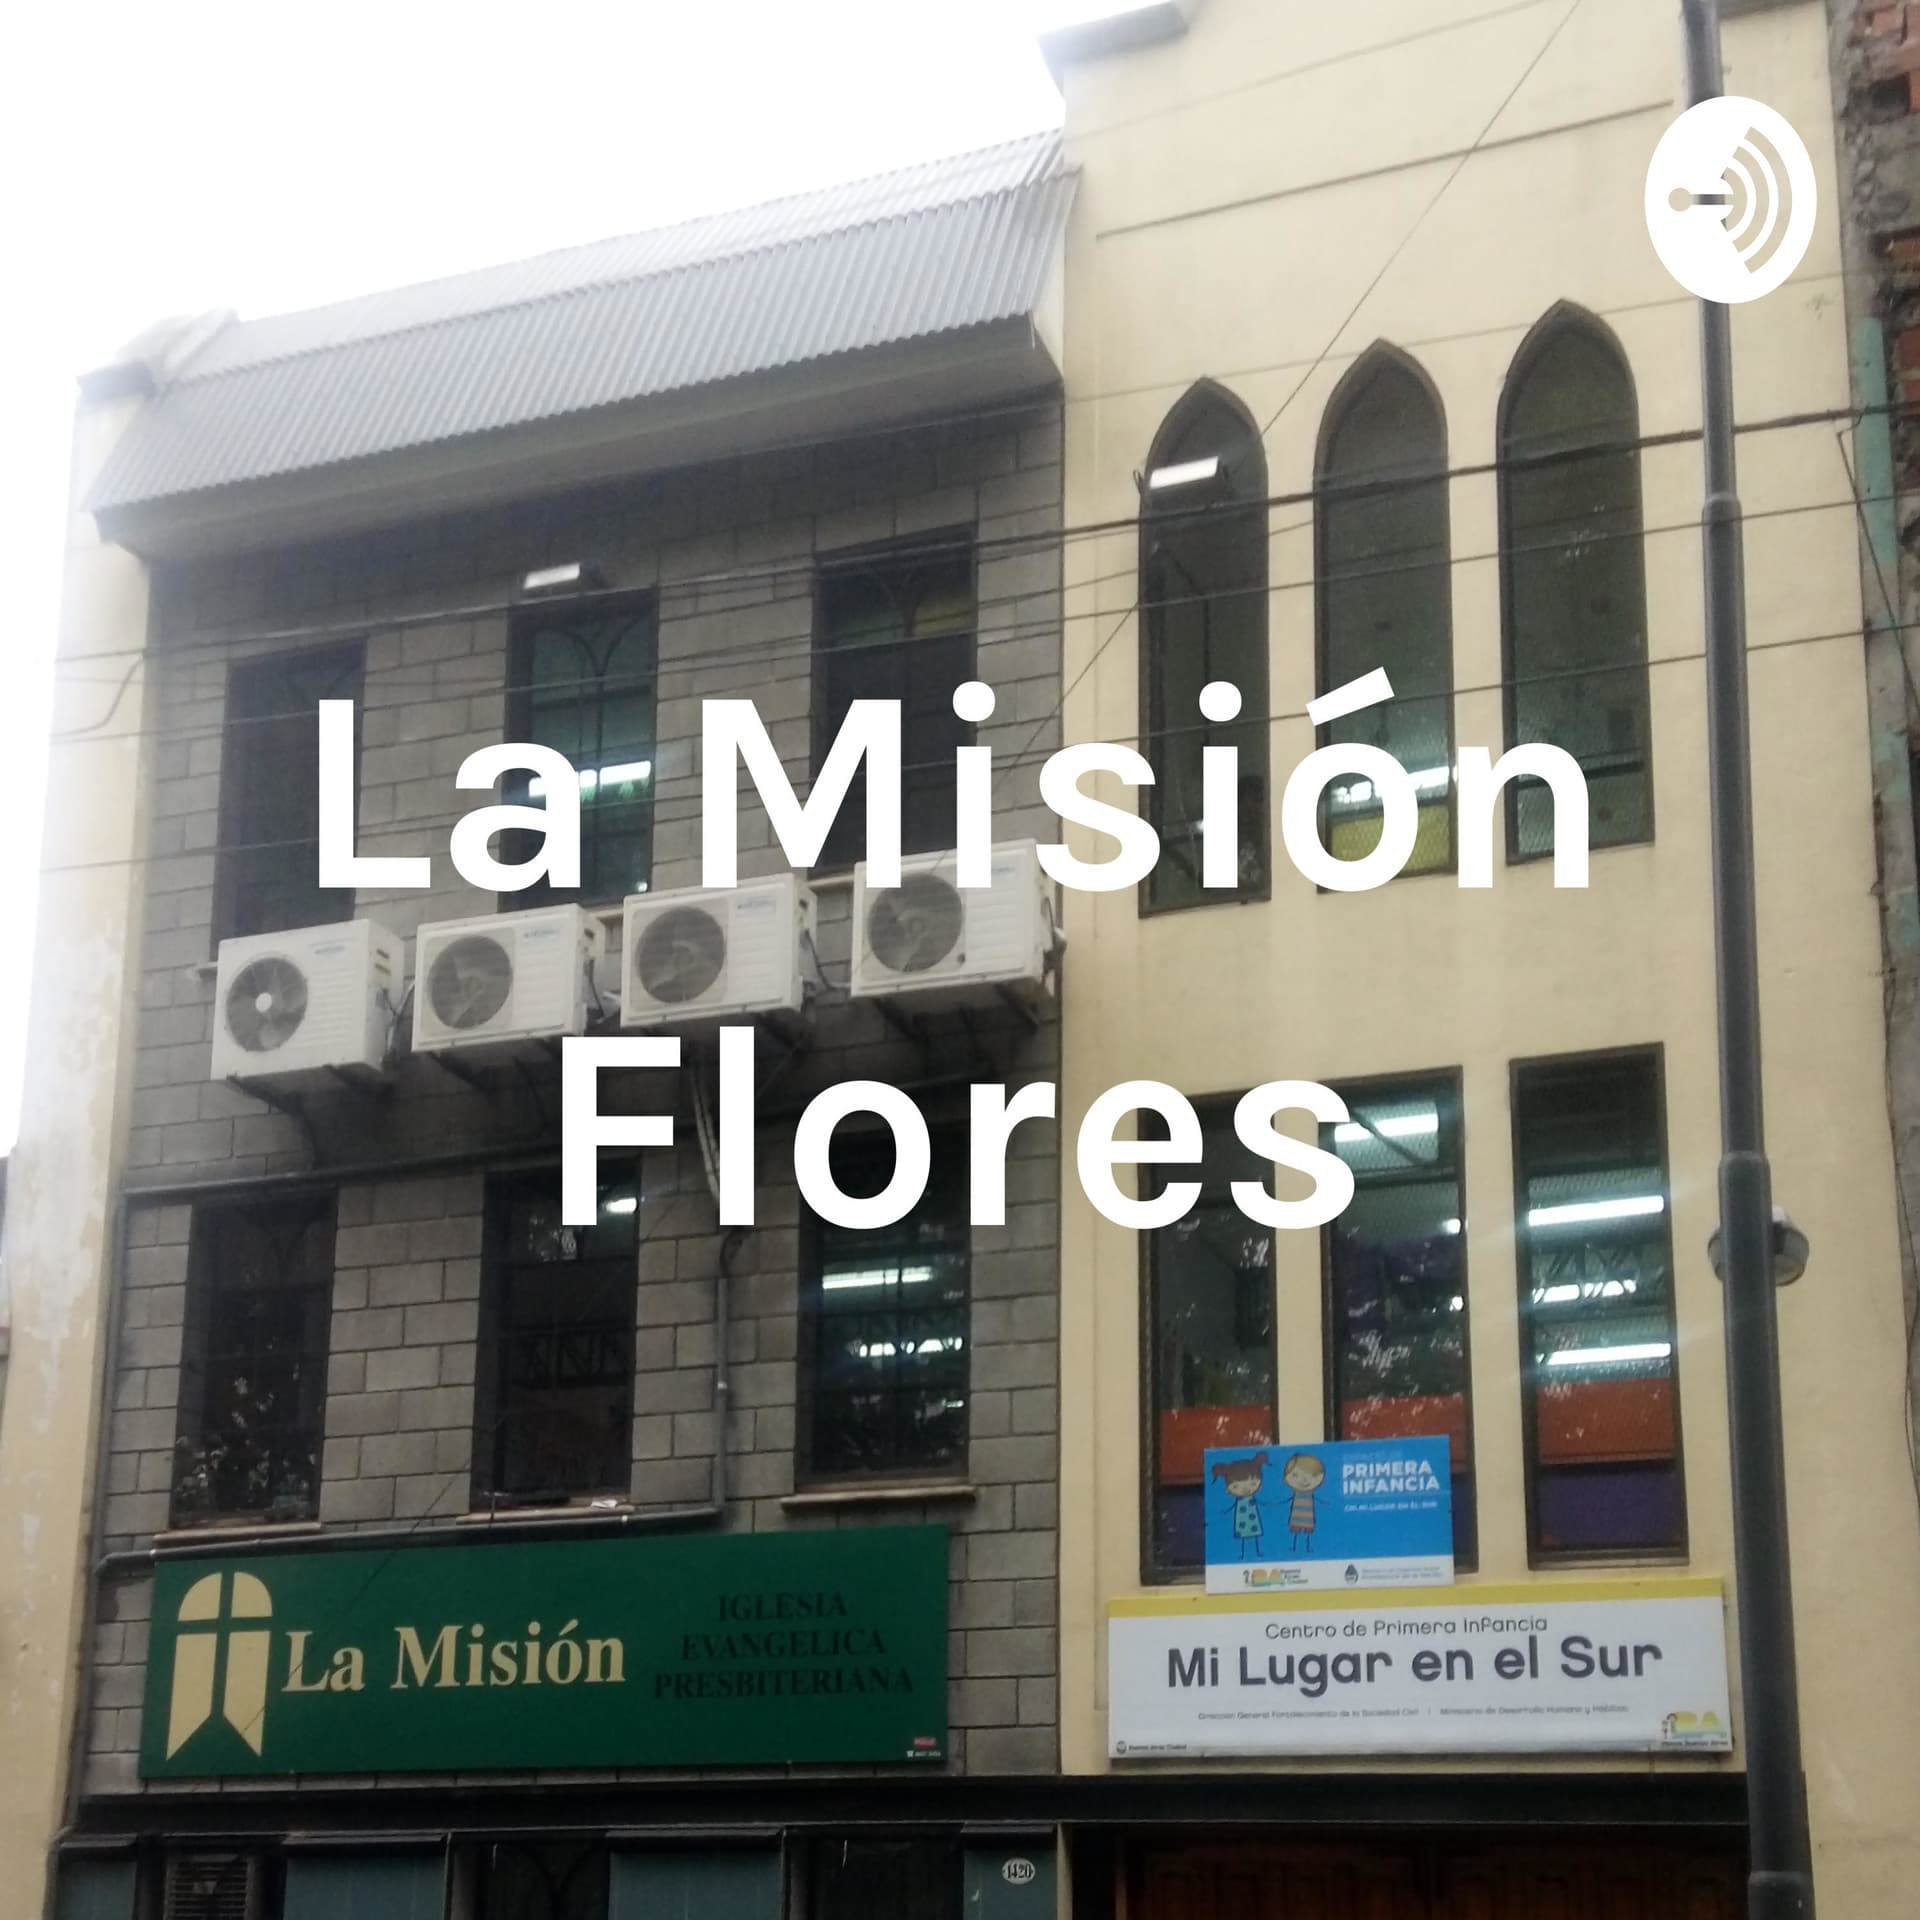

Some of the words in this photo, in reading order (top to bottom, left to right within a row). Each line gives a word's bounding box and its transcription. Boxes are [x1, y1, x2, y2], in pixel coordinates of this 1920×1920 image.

[1343, 1460, 1432, 1478] PRIMERA
[1343, 1475, 1440, 1495] INFANCIA
[717, 1592, 848, 1622] IGLESIA
[1265, 1622, 1336, 1640] Centro
[1343, 1621, 1367, 1637] de
[1374, 1619, 1456, 1636] Primera
[1463, 1616, 1548, 1633] Infancia
[281, 1630, 366, 1692] La
[390, 1619, 626, 1689] Misión
[681, 1627, 886, 1661] EVANGELICA
[1168, 1647, 1219, 1687] Mi
[1238, 1646, 1393, 1698] Lugar
[1412, 1648, 1474, 1682] en
[1493, 1635, 1539, 1679] el
[1560, 1636, 1663, 1678] Sur
[654, 1667, 914, 1699] PRESBITERIANA
[1007, 1863, 1032, 1879] 1420
